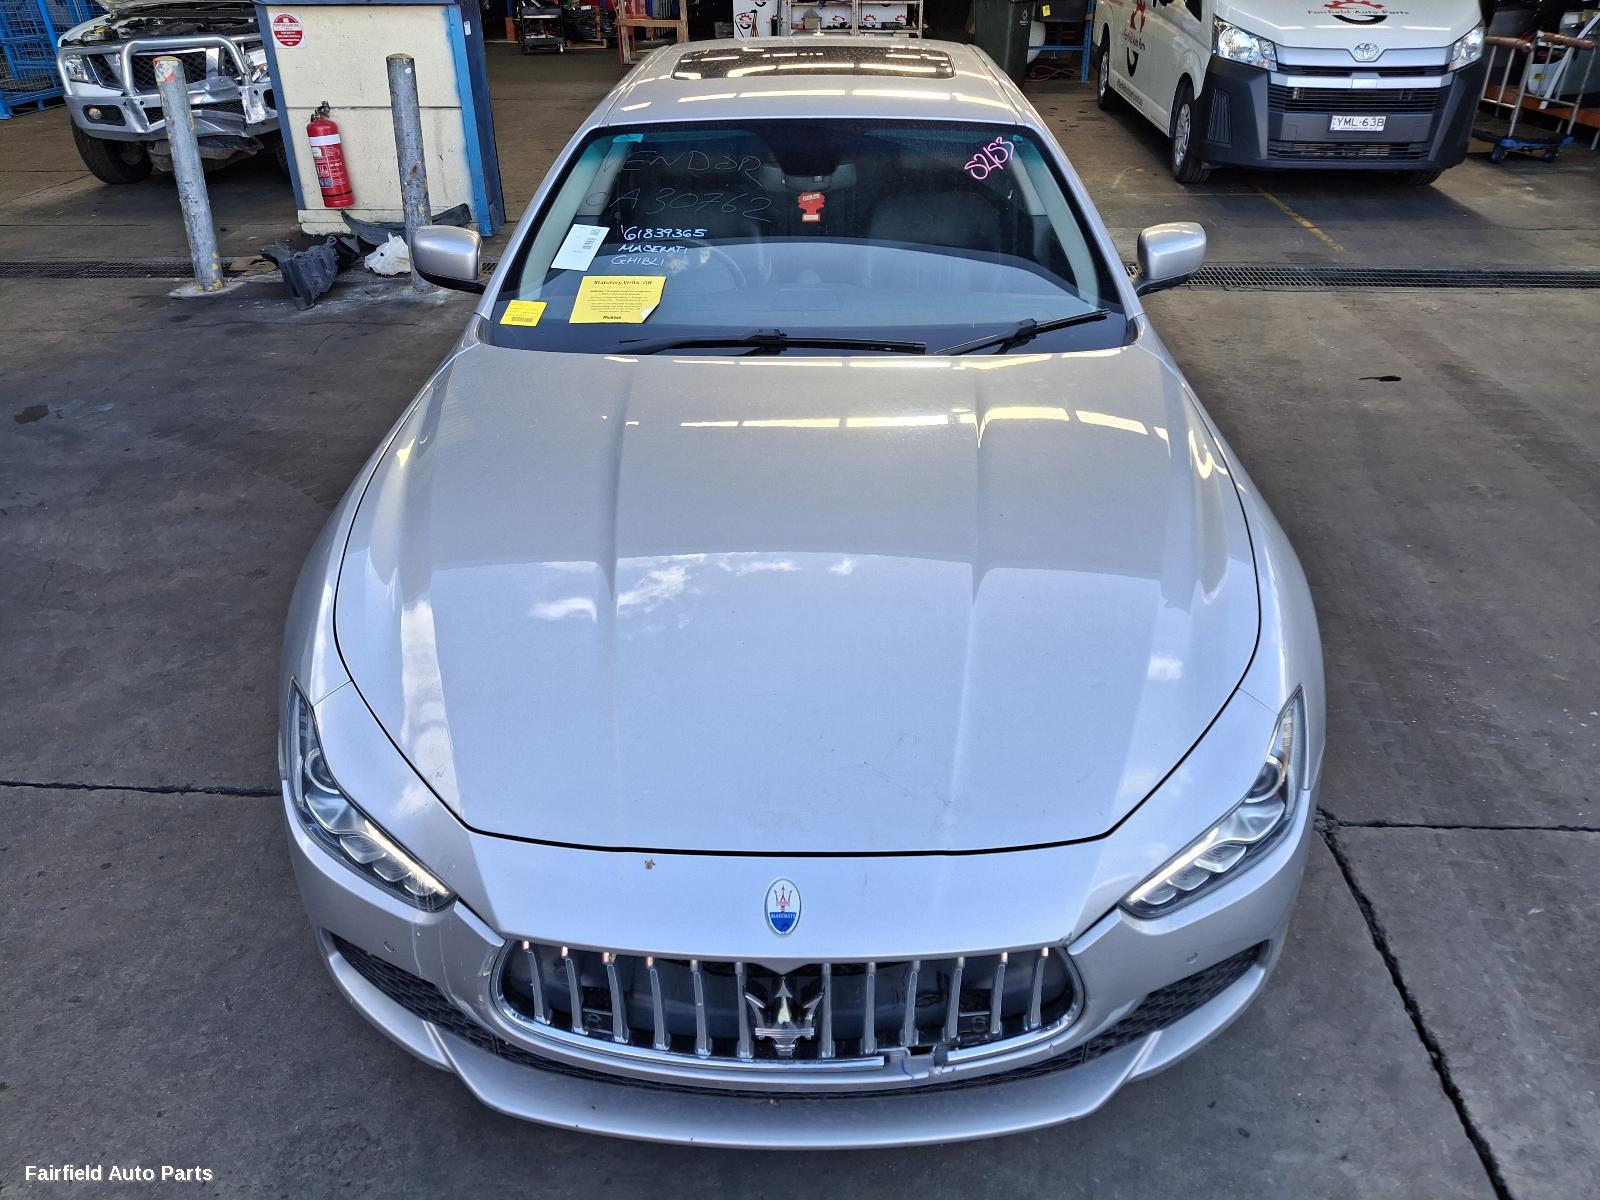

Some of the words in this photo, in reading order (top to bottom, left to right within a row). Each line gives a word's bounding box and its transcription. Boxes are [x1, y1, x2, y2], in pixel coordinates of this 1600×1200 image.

[623, 226, 708, 241] 61839365
[618, 244, 688, 255] MASERATI
[611, 255, 665, 267] GHIBLI
